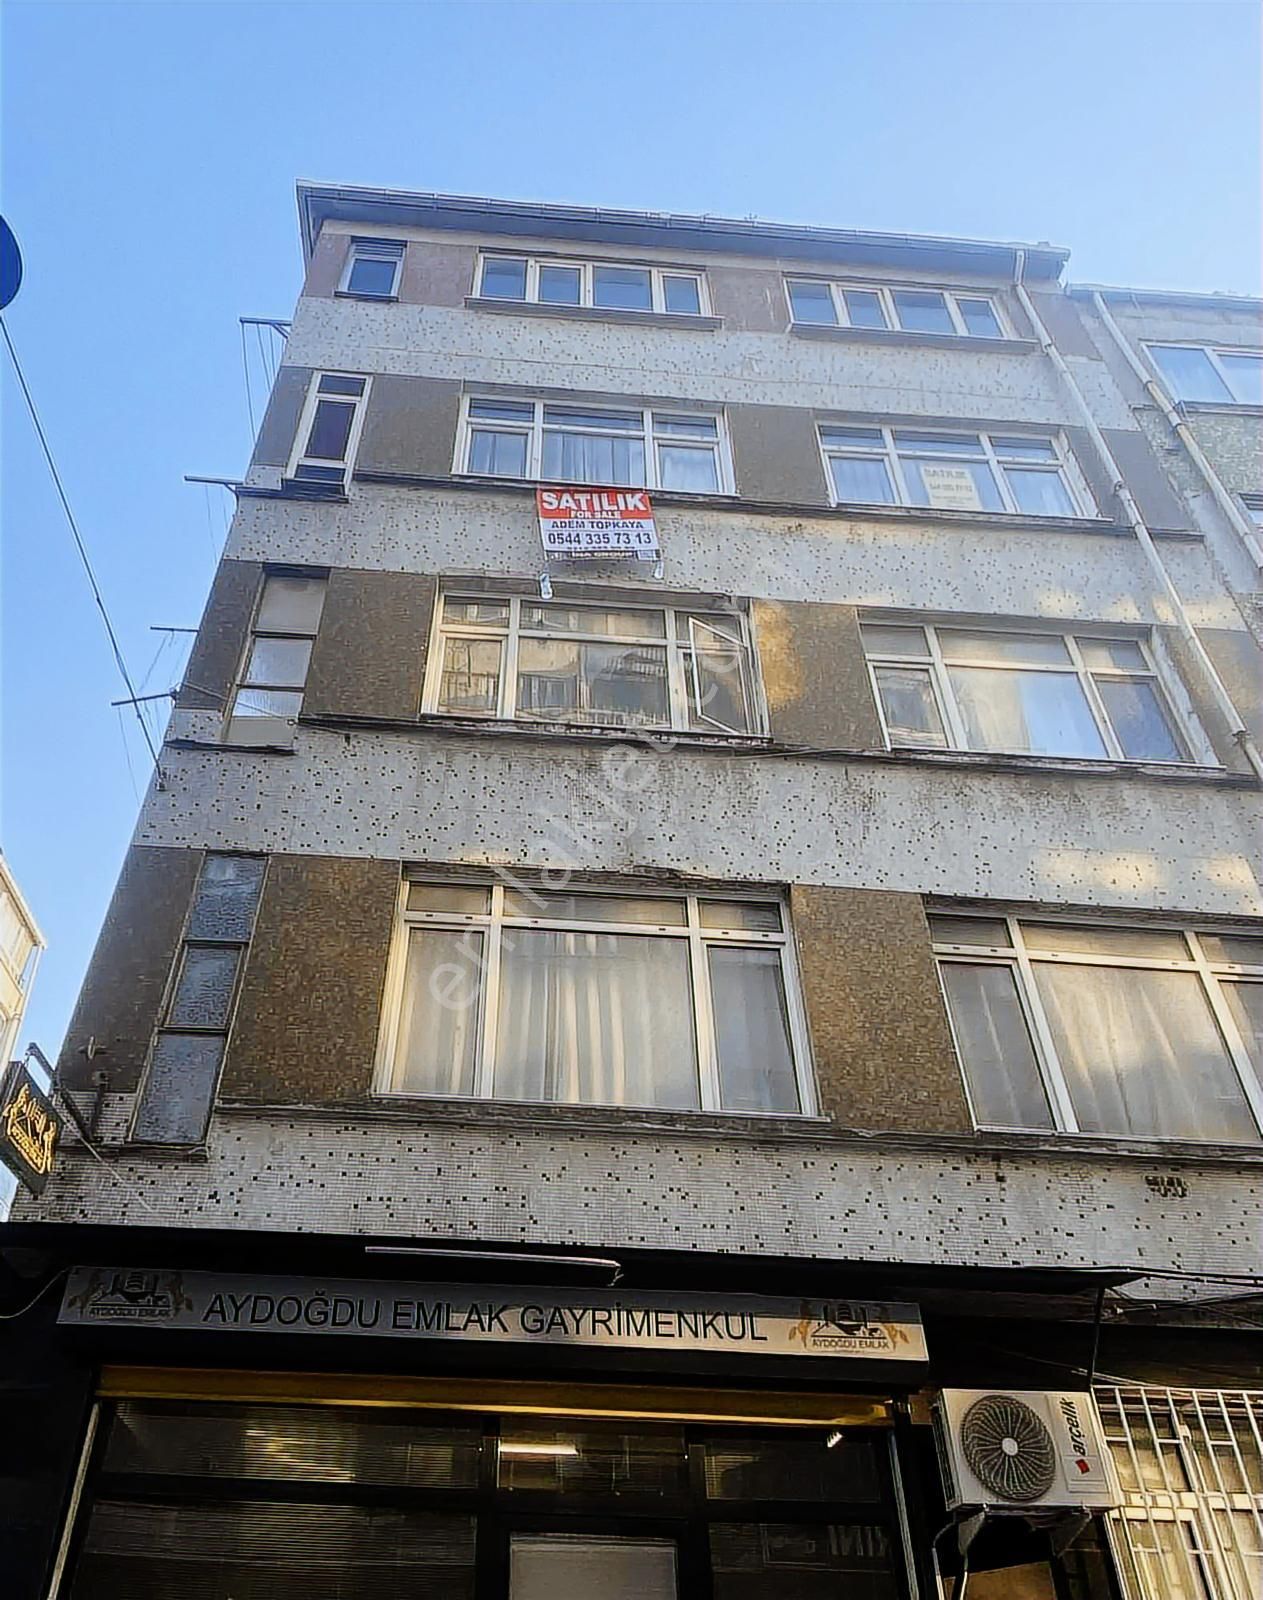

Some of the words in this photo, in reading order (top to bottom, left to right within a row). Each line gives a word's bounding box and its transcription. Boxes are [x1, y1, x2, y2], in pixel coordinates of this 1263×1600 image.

[541, 491, 647, 511] SATILIK
[571, 510, 592, 518] FOR
[596, 511, 621, 519] SALE
[551, 520, 585, 529] ADEM
[590, 521, 644, 530] TOPKAYA
[548, 532, 581, 545] 0544
[585, 533, 610, 545] 335
[614, 532, 631, 545] 73
[635, 532, 652, 545] 13
[202, 1289, 381, 1328] AYDOĞDU
[391, 1300, 509, 1333] EMLAK
[520, 1302, 768, 1341] GAYRİMENKUL
[1059, 1397, 1086, 1457] arçelik
